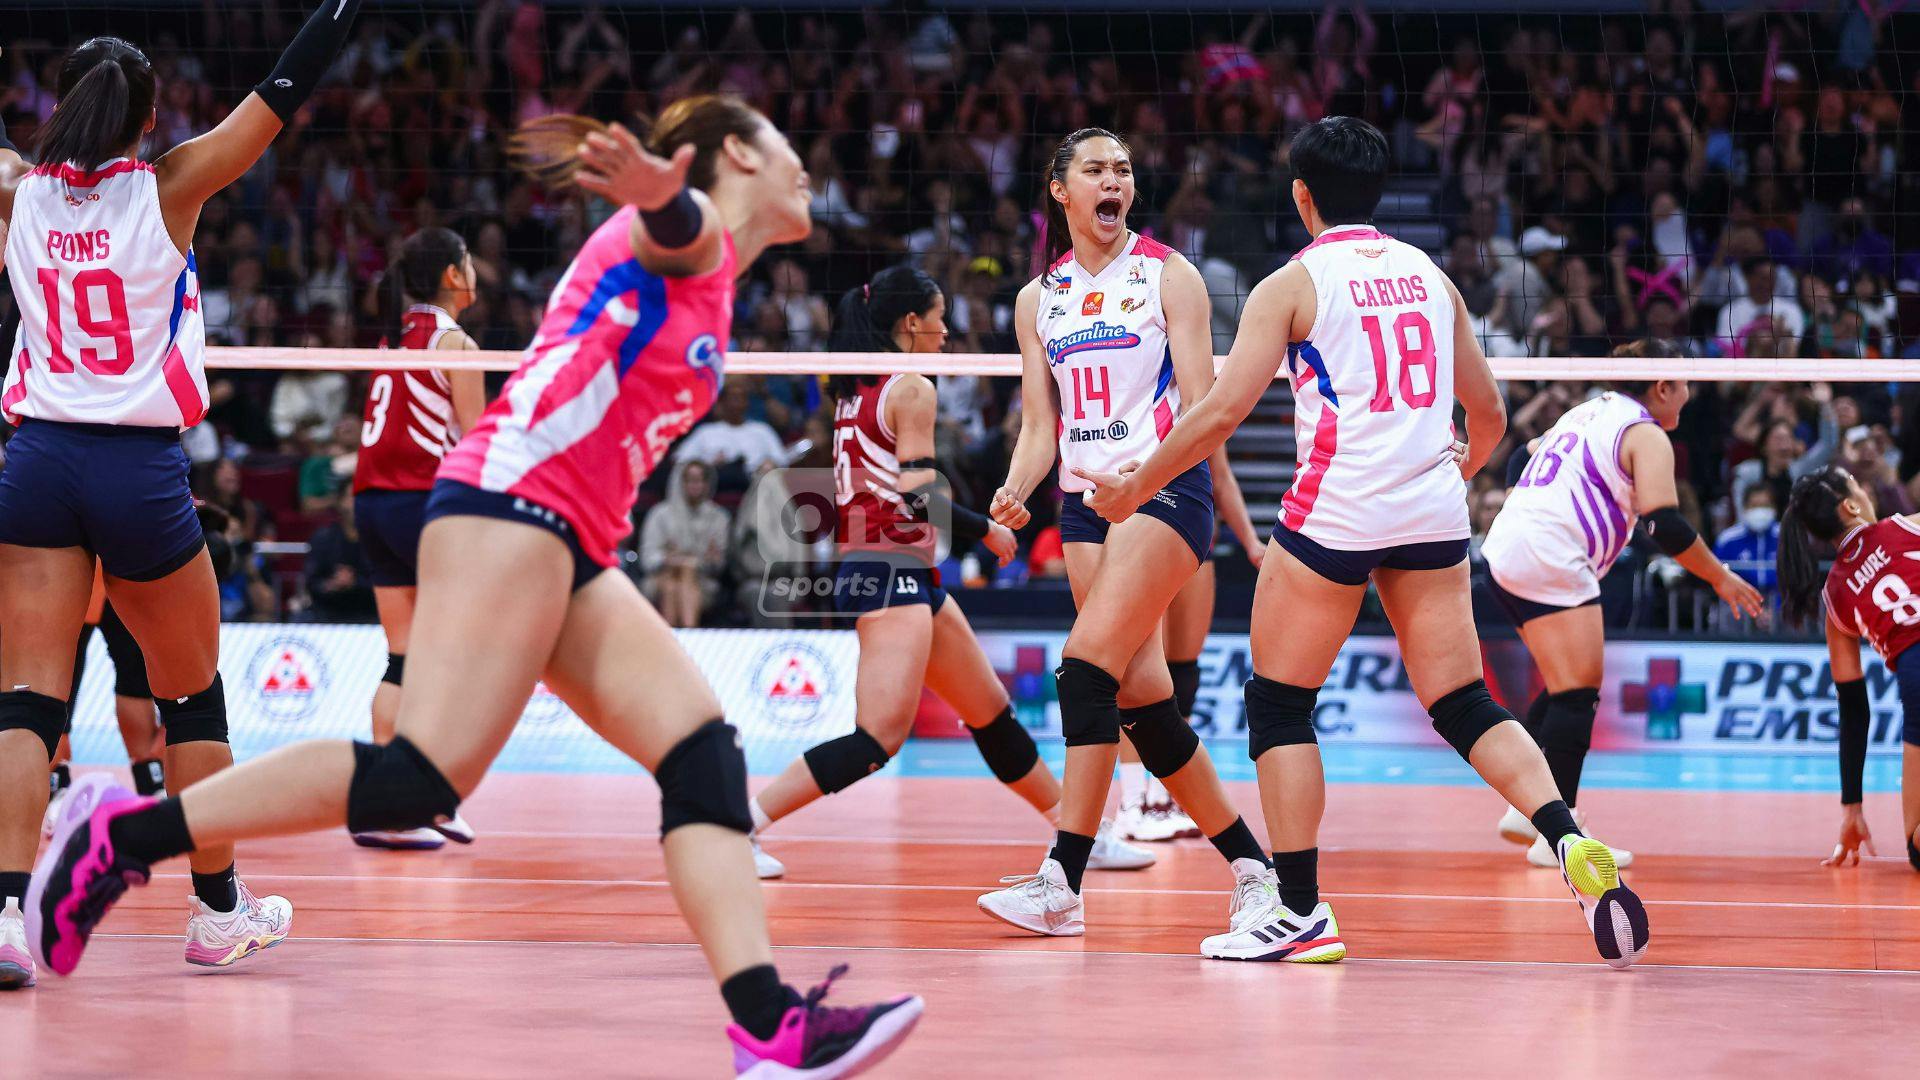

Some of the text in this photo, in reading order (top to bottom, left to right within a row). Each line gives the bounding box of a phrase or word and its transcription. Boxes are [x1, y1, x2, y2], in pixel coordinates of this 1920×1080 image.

[47, 229, 110, 262] PONS
[1348, 275, 1428, 308] CARLOS
[37, 267, 135, 376] 19
[1047, 321, 1127, 367] Creamline
[1360, 311, 1437, 413] 18
[361, 373, 393, 448] 3
[1071, 366, 1111, 420] 14
[1069, 428, 1107, 443] Allianz
[1517, 432, 1579, 488] 16
[896, 576, 919, 594] 15
[1846, 544, 1892, 596] LAURE
[1872, 573, 1920, 626] 8
